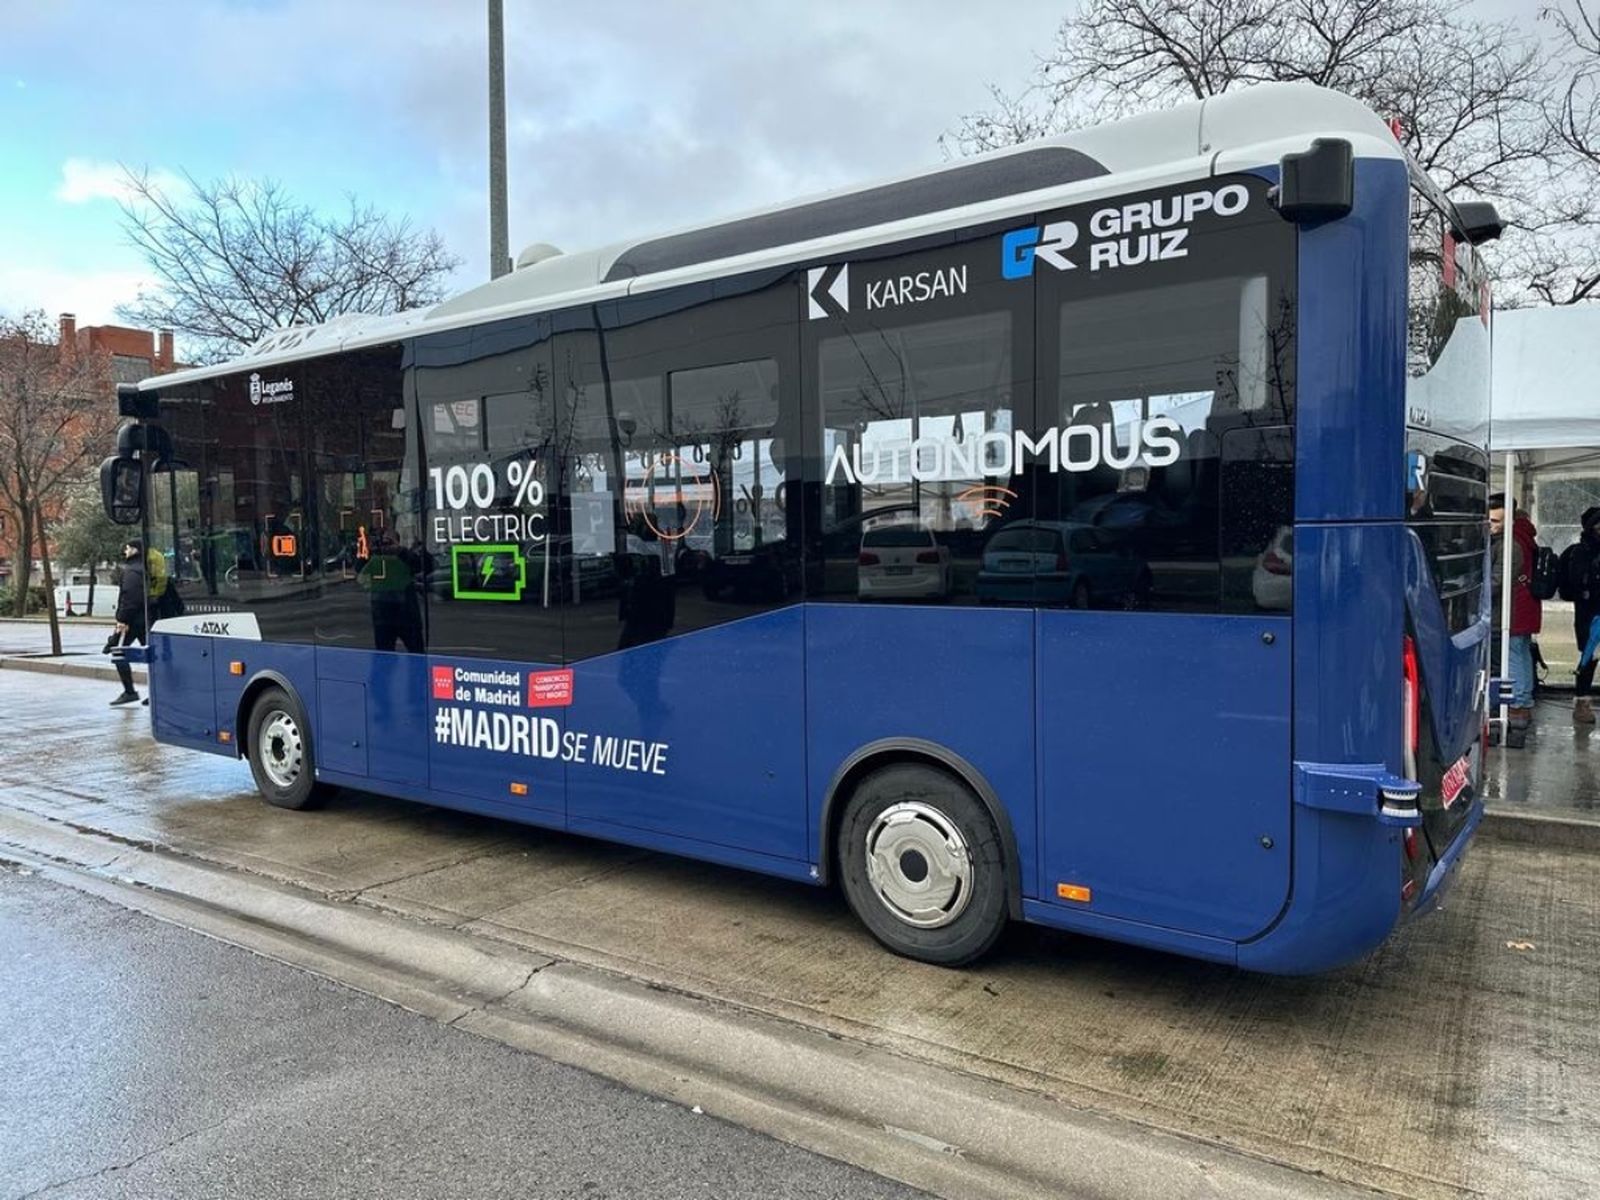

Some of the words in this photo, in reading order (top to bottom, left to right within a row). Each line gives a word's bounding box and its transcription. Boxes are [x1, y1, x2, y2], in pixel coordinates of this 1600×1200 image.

[1090, 184, 1249, 238] GRUPO
[1090, 228, 1189, 271] RUIZ
[866, 265, 967, 310] KARSAN
[825, 416, 1181, 485] AUTONOMOUS
[429, 462, 495, 510] 100
[507, 460, 543, 507] %
[434, 512, 545, 544] ELECTRIC
[454, 667, 520, 686] Comunidad
[455, 686, 471, 701] de
[474, 687, 520, 707] Madrid
[435, 707, 560, 759] #MADRID
[561, 730, 588, 763] SE
[592, 735, 669, 775] MUEVE
